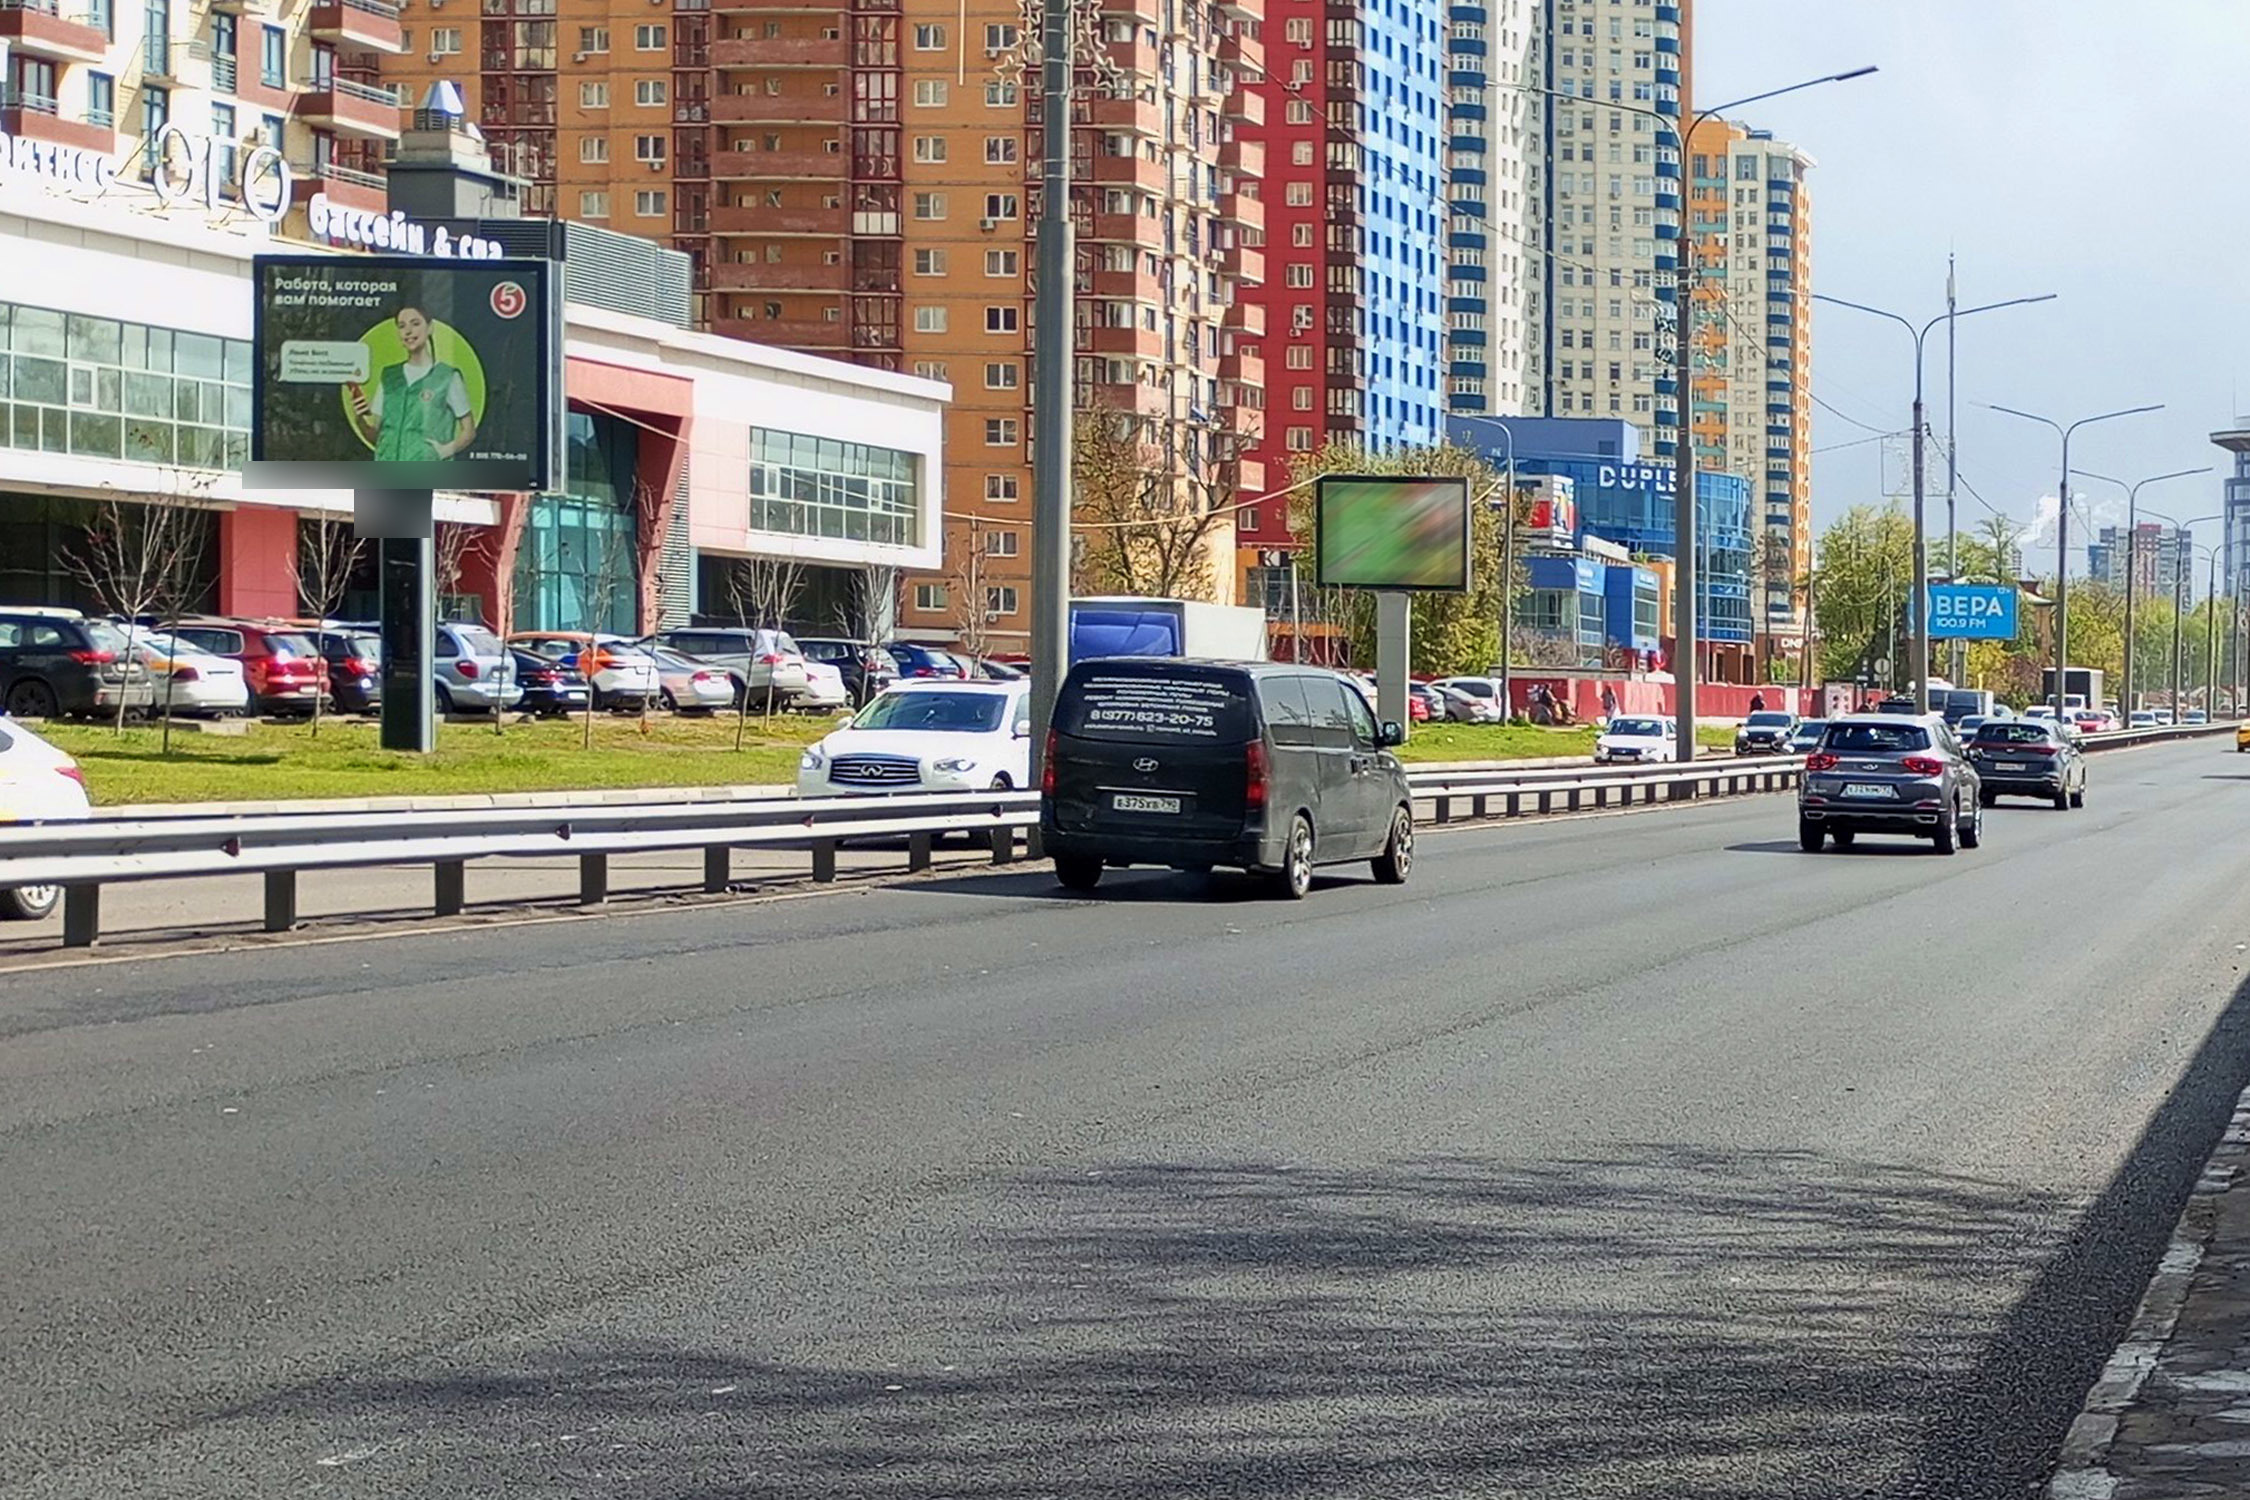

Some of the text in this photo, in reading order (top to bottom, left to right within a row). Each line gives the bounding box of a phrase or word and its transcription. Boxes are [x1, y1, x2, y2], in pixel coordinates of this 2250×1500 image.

[309, 192, 424, 254] бассейн
[434, 225, 452, 258] &
[275, 277, 397, 293] Работа, которая
[275, 294, 382, 308] вам помогает
[1936, 595, 2004, 617] ВЕРА
[1936, 617, 1986, 629] 100.9 FM
[1090, 709, 1101, 720] 8
